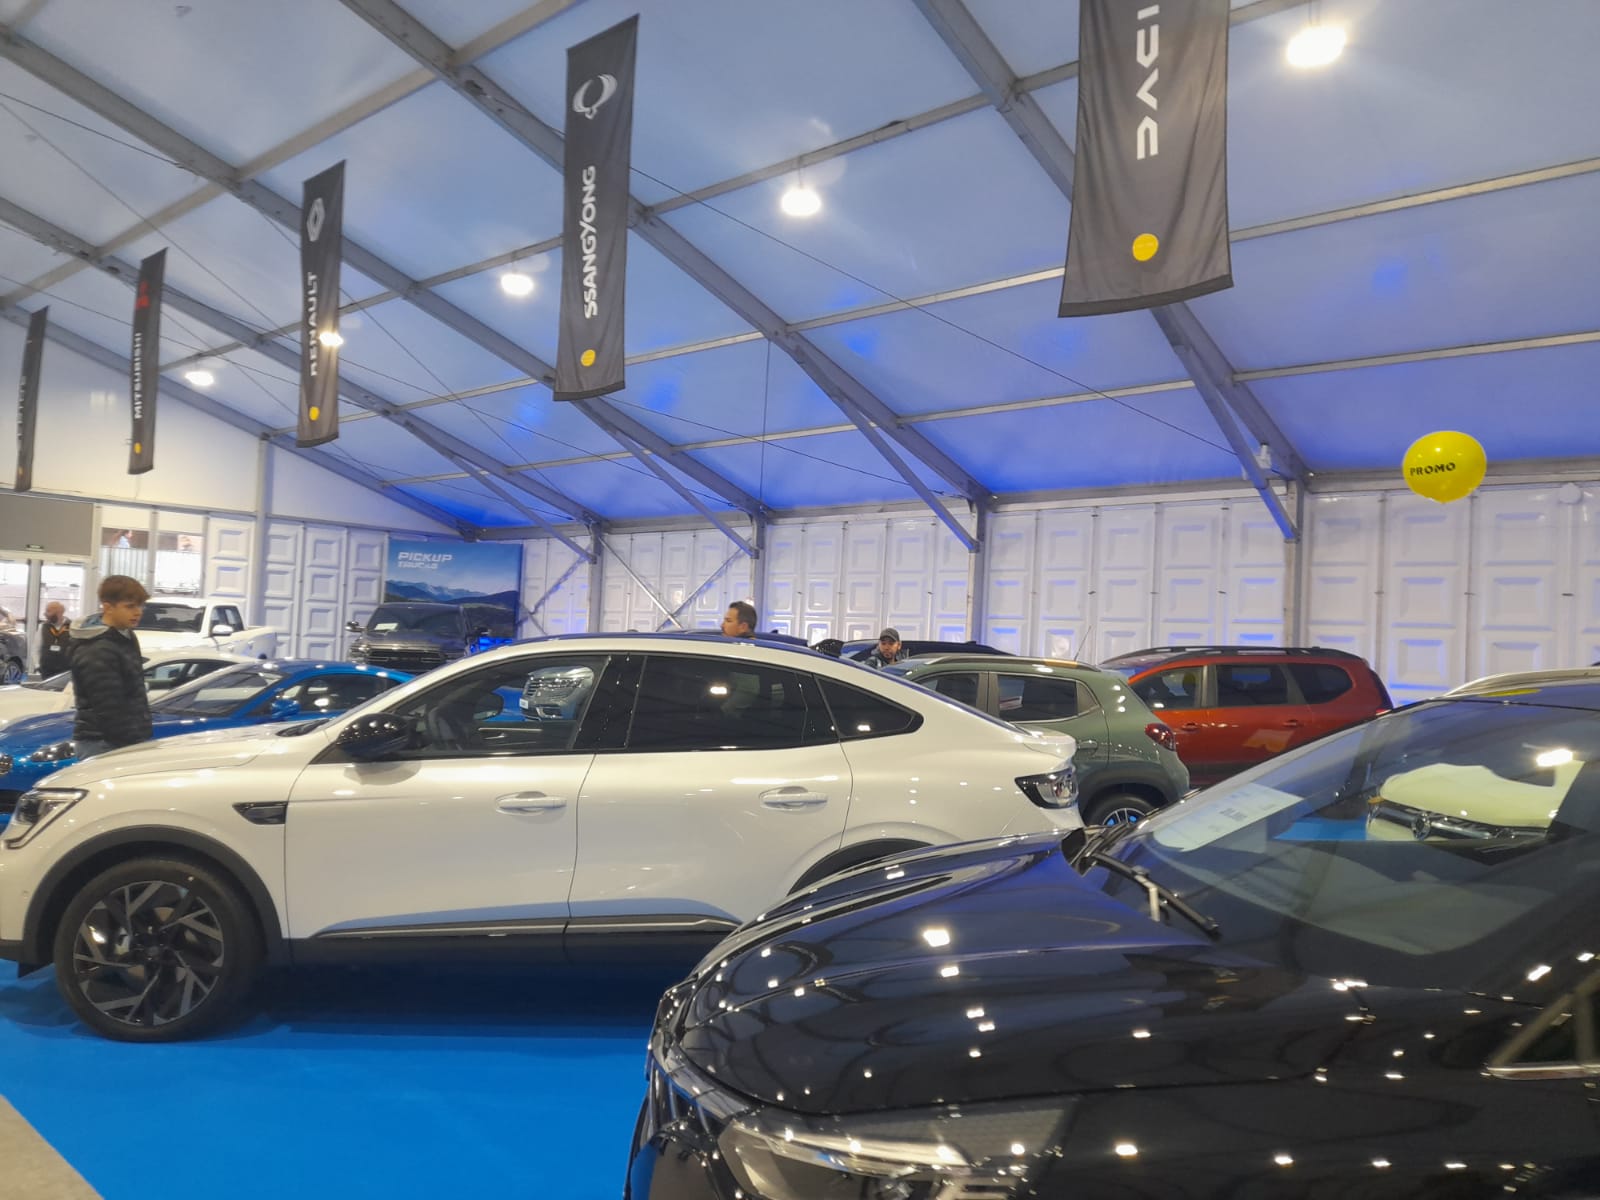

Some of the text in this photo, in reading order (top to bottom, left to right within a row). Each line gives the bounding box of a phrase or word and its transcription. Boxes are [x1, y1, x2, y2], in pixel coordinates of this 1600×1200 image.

[579, 165, 598, 319] SSANGYONG
[307, 271, 318, 376] RENAULT
[134, 332, 142, 419] MITSUBISHI
[1409, 462, 1456, 477] PROMO
[398, 551, 452, 562] PICKUP
